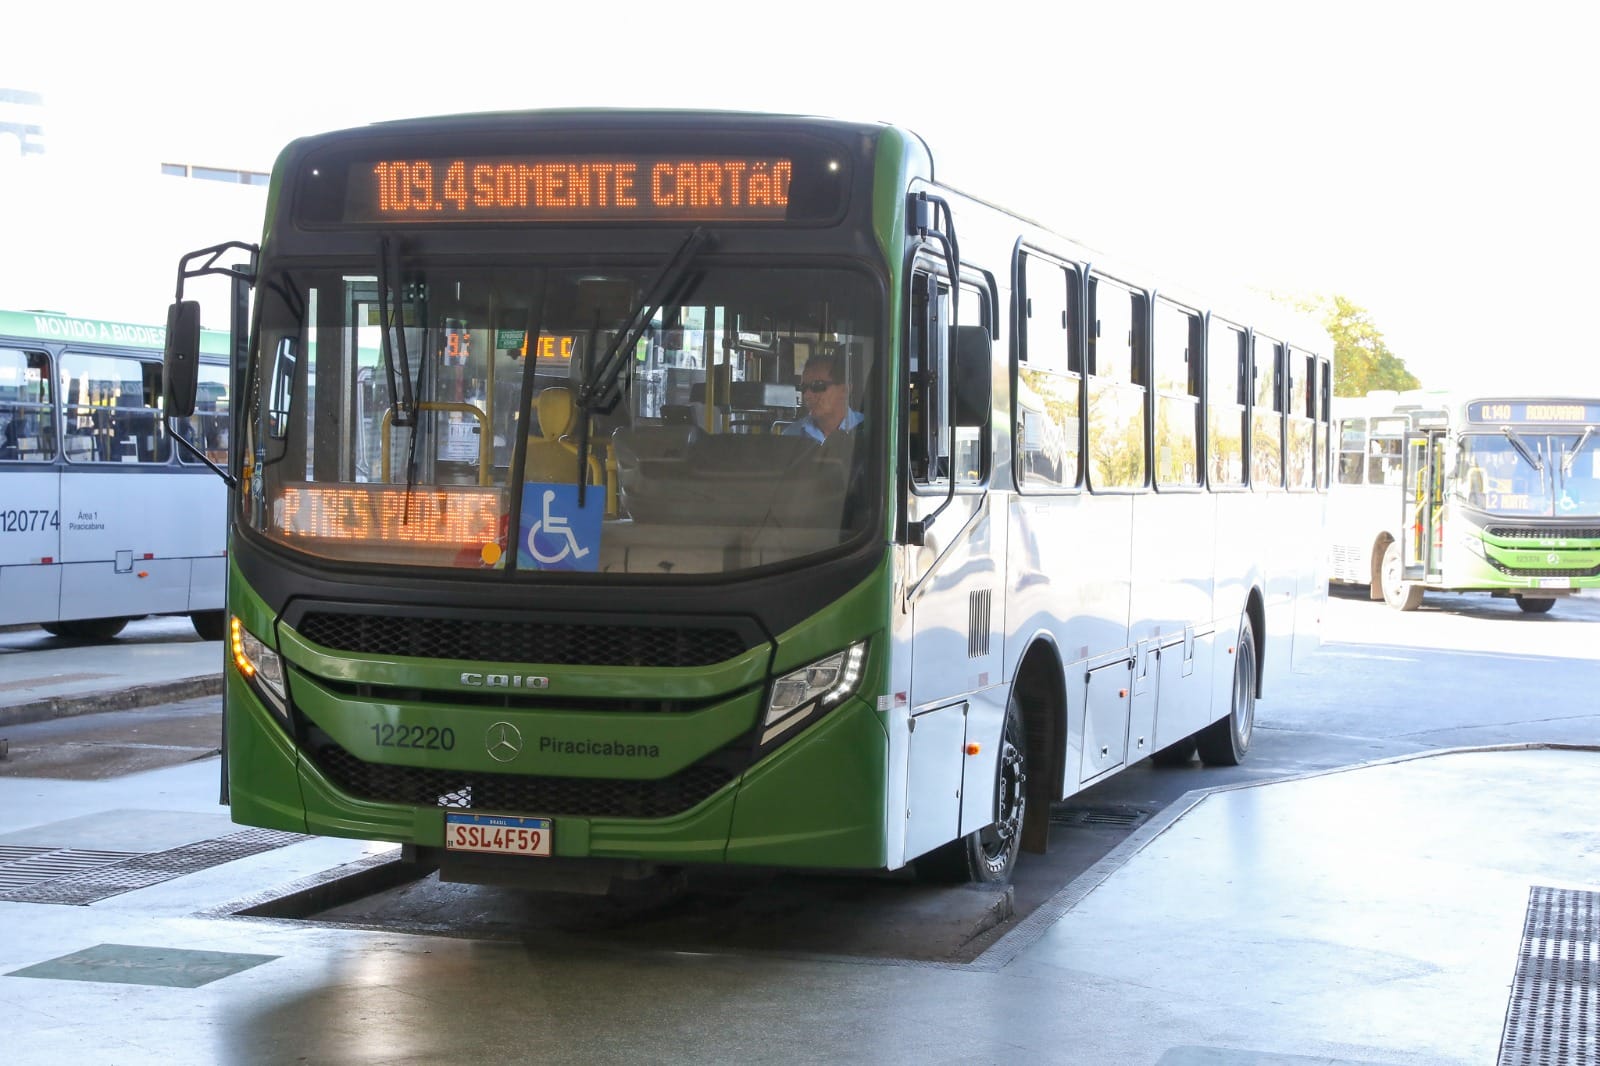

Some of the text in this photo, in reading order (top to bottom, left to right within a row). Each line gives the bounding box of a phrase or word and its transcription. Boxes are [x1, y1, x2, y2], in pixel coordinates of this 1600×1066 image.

[374, 161, 468, 210] 109.4
[473, 163, 637, 206] SOMENTE
[34, 315, 167, 345] MOVIDO A BIODIES
[0, 509, 60, 532] 120774
[460, 672, 549, 689] CAIO
[371, 723, 456, 751] 122220
[539, 735, 660, 759] Piracicabana
[456, 825, 541, 851] SSL4F59
